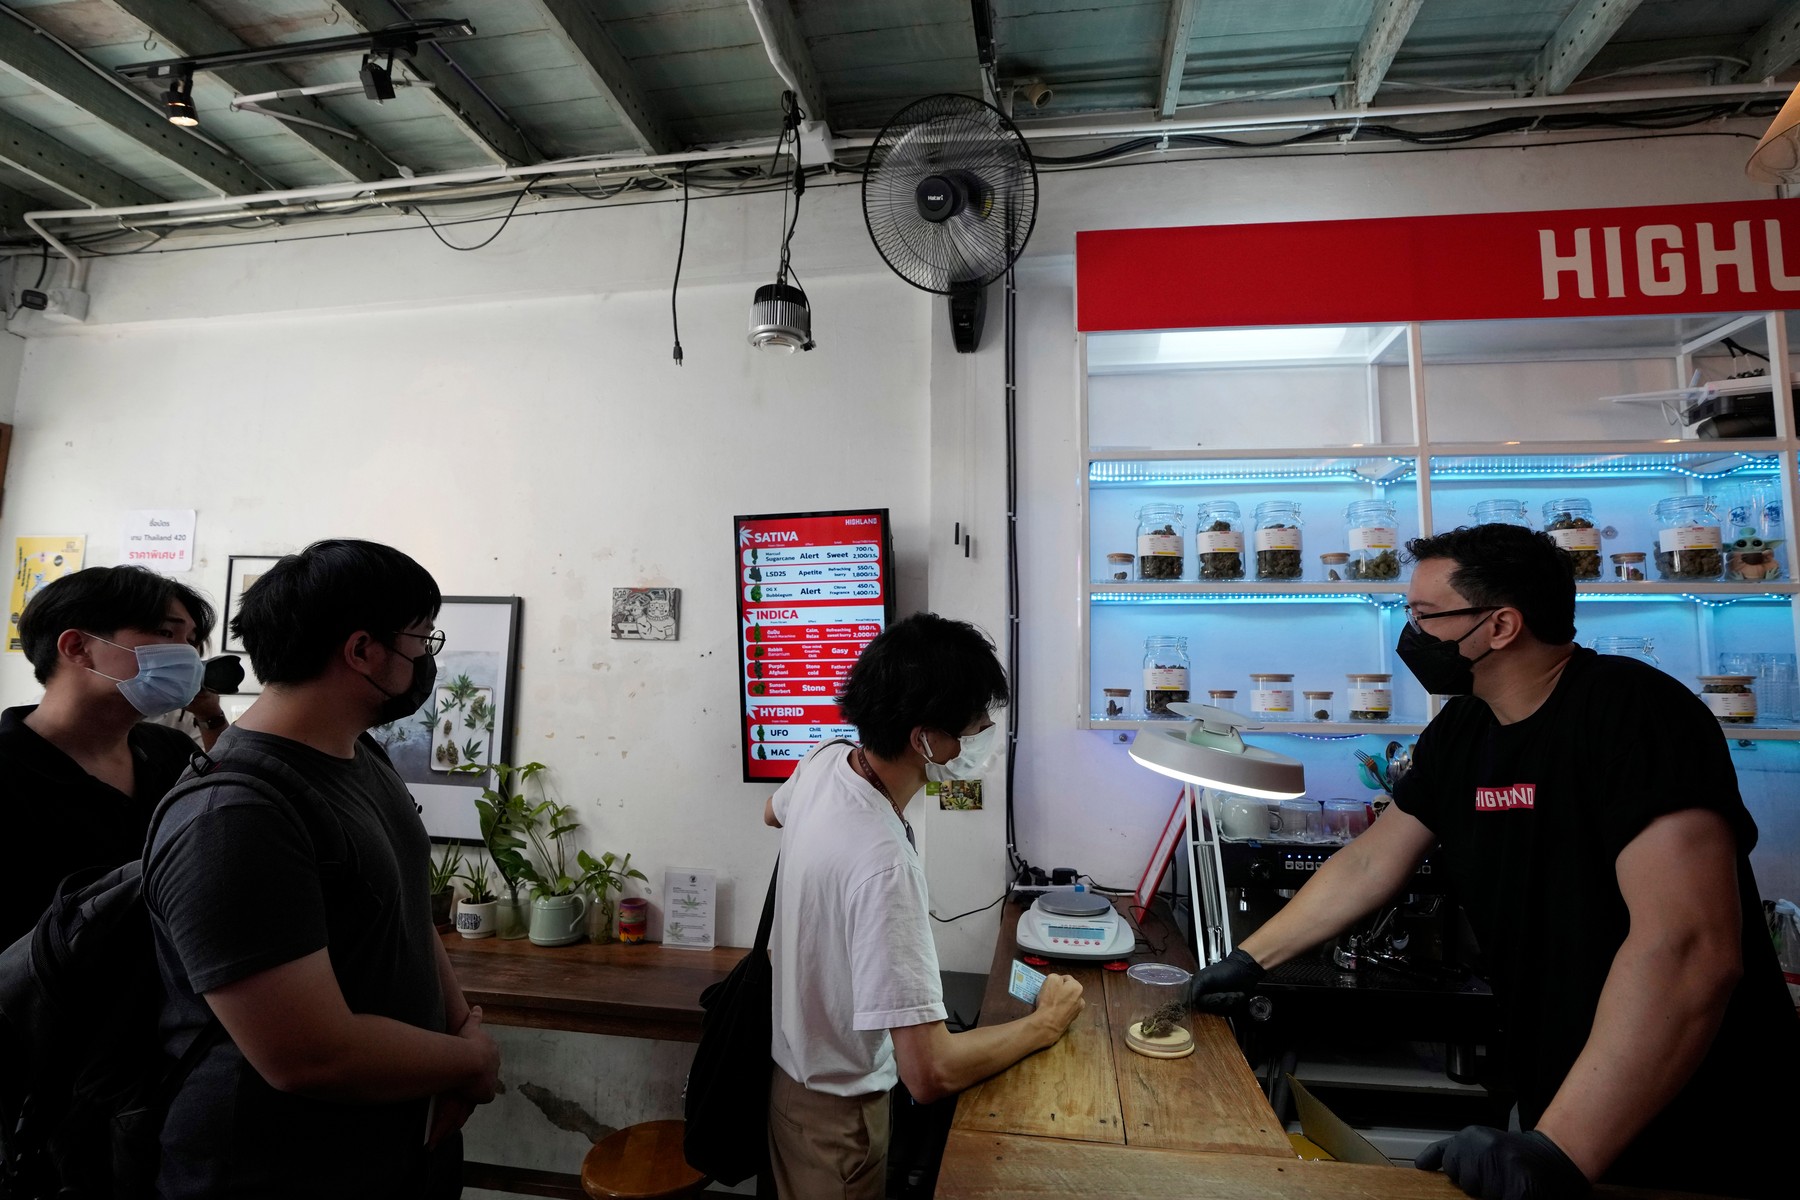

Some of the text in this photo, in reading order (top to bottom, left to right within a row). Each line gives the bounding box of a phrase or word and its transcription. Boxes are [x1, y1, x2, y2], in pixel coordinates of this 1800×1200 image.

[1538, 219, 1800, 300] HIGHL
[845, 518, 877, 526] HIGHLAND
[754, 531, 798, 543] SATIVA
[129, 549, 176, 559] ราคาพิเศษ
[756, 610, 799, 620] INDICA
[760, 707, 804, 717] HYBRID
